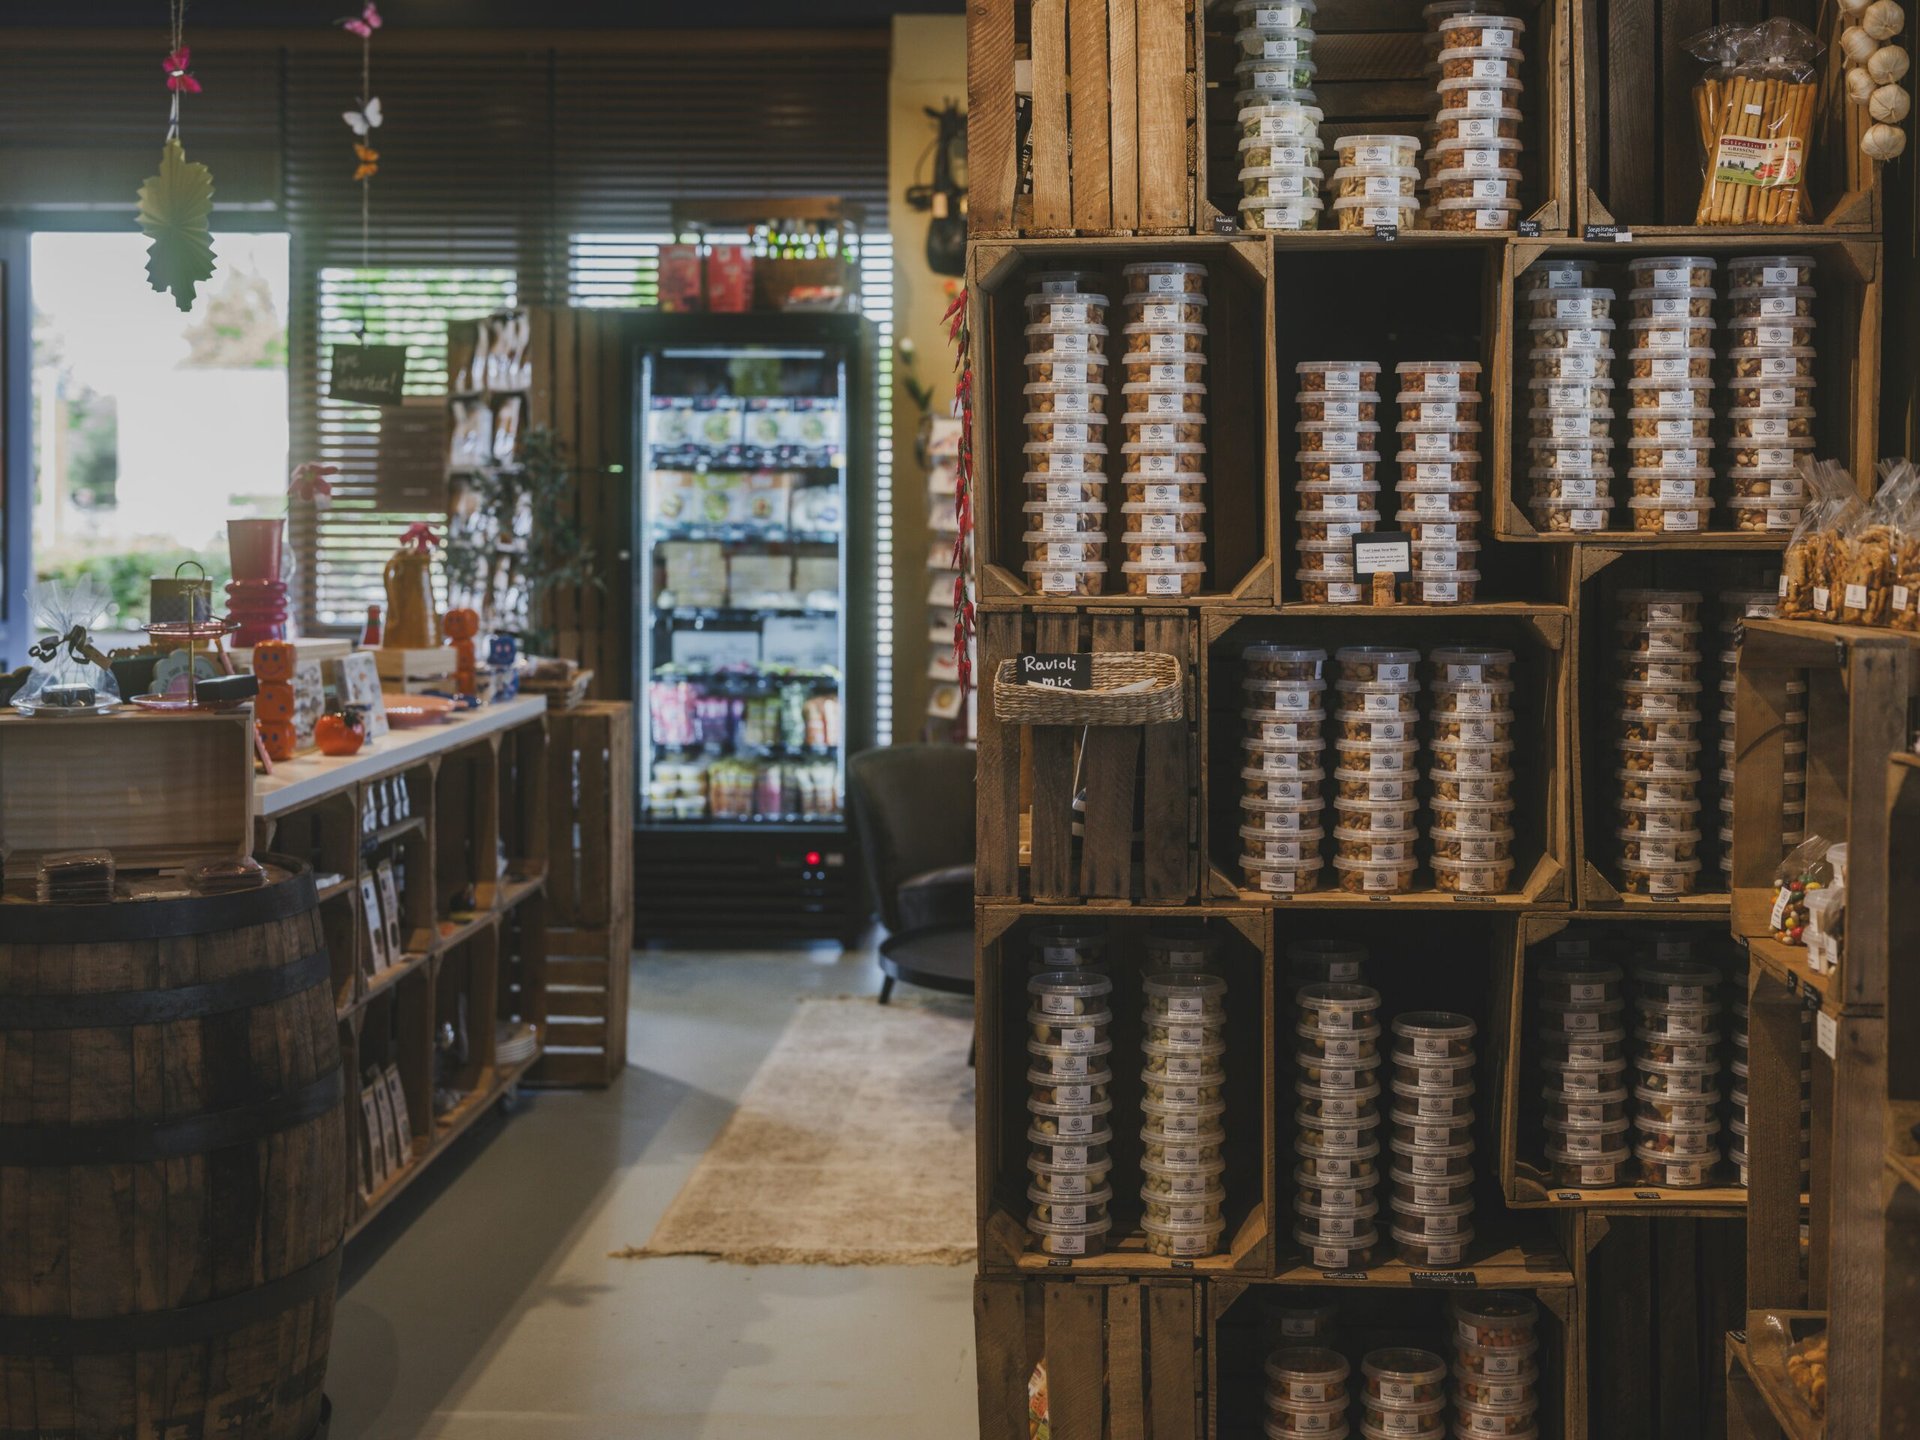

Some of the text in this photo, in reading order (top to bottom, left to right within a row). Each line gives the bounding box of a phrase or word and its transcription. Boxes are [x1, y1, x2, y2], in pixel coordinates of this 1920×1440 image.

[1723, 138, 1764, 149] Stiratini
[1022, 655, 1077, 672] Ravioli
[1041, 676, 1072, 687] mix
